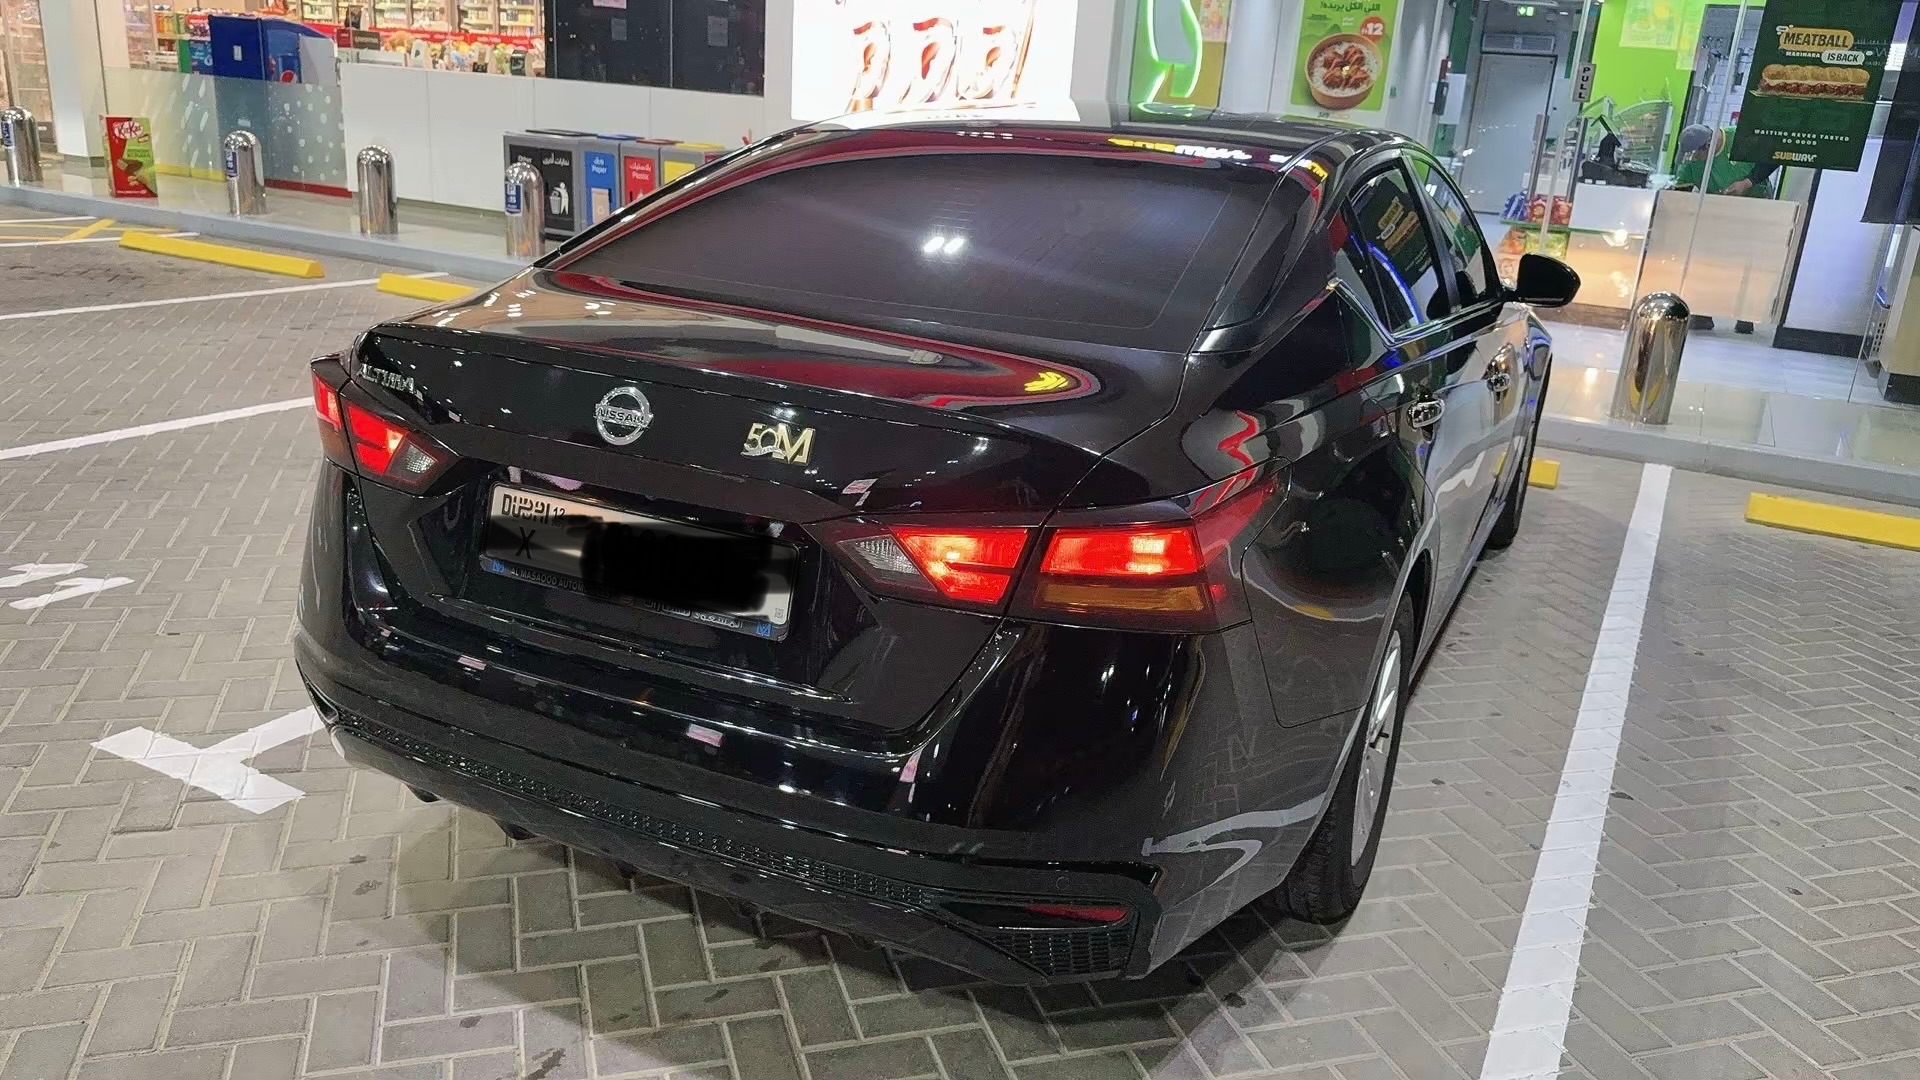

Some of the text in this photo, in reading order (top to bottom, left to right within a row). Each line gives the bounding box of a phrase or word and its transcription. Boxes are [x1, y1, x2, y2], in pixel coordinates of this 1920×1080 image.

[1367, 22, 1384, 35] 12
[1784, 32, 1849, 48] MEATBALL
[1827, 53, 1860, 62] IS BACK
[1578, 67, 1591, 99] PULL
[1772, 151, 1817, 162] SUBWAY
[592, 165, 607, 174] Paper
[632, 171, 649, 180] Plastic
[356, 363, 414, 394] ALTIMA
[597, 407, 645, 424] NISSAN
[515, 526, 536, 559] X
[511, 567, 519, 576] AL
[520, 569, 558, 586] MASAOOD
